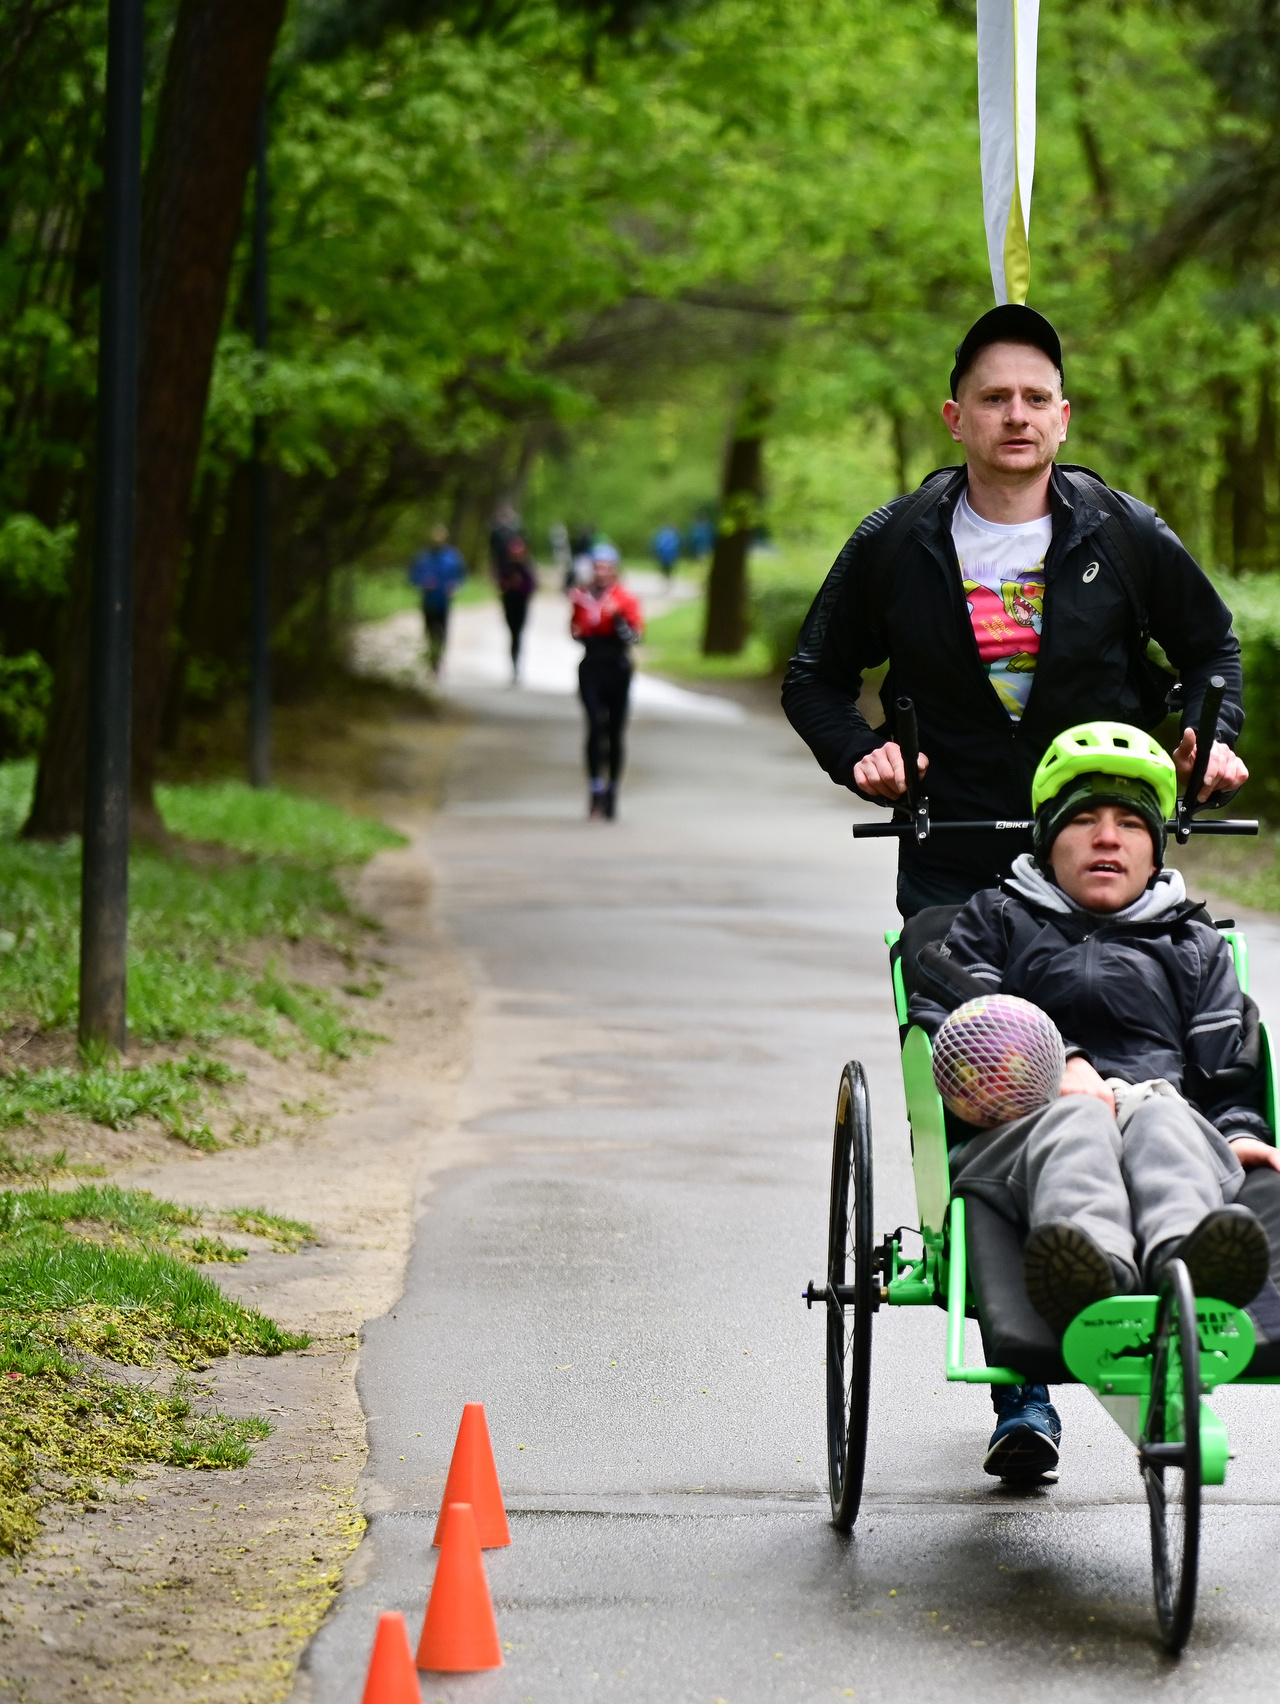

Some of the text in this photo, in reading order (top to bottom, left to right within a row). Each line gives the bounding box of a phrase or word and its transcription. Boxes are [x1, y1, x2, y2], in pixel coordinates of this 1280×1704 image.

[979, 619, 1003, 642] МОЖЕШЬ
[991, 621, 1003, 634] ЧЕМ
[992, 614, 1015, 636] БОЛЬШЕ
[995, 820, 1030, 829] 4BIKE
